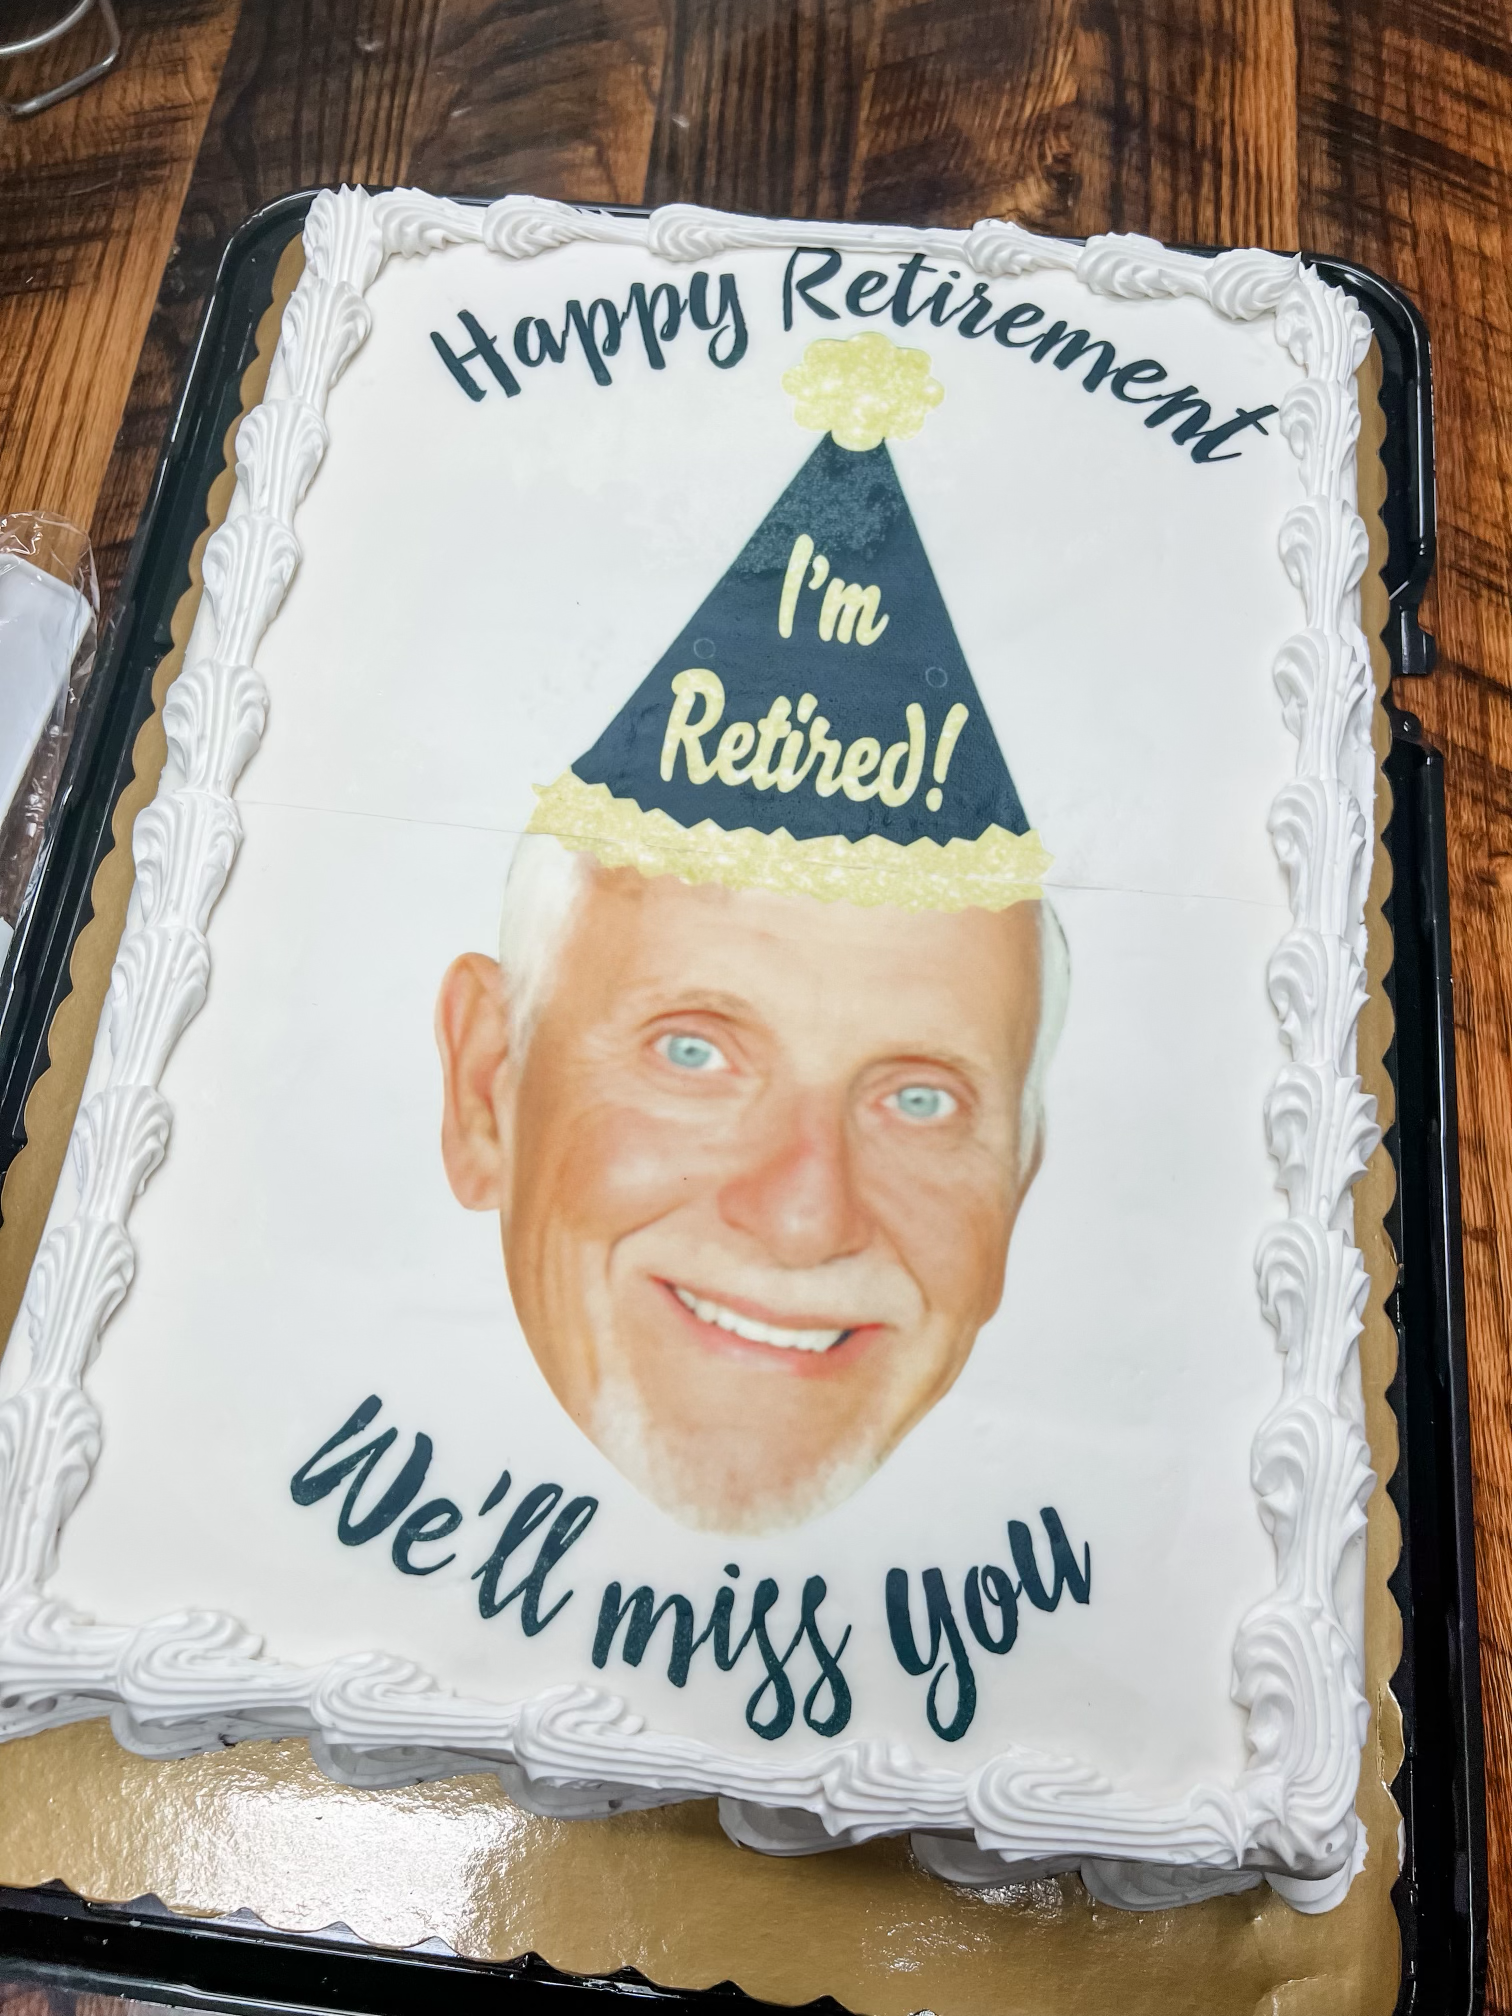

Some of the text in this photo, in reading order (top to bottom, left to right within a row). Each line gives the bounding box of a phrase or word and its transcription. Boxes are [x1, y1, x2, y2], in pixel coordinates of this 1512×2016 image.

[429, 245, 1281, 464] Happy Retirement
[778, 534, 889, 646] I'm
[660, 668, 969, 813] Retired!
[289, 1393, 1092, 1743] We'll miss you
